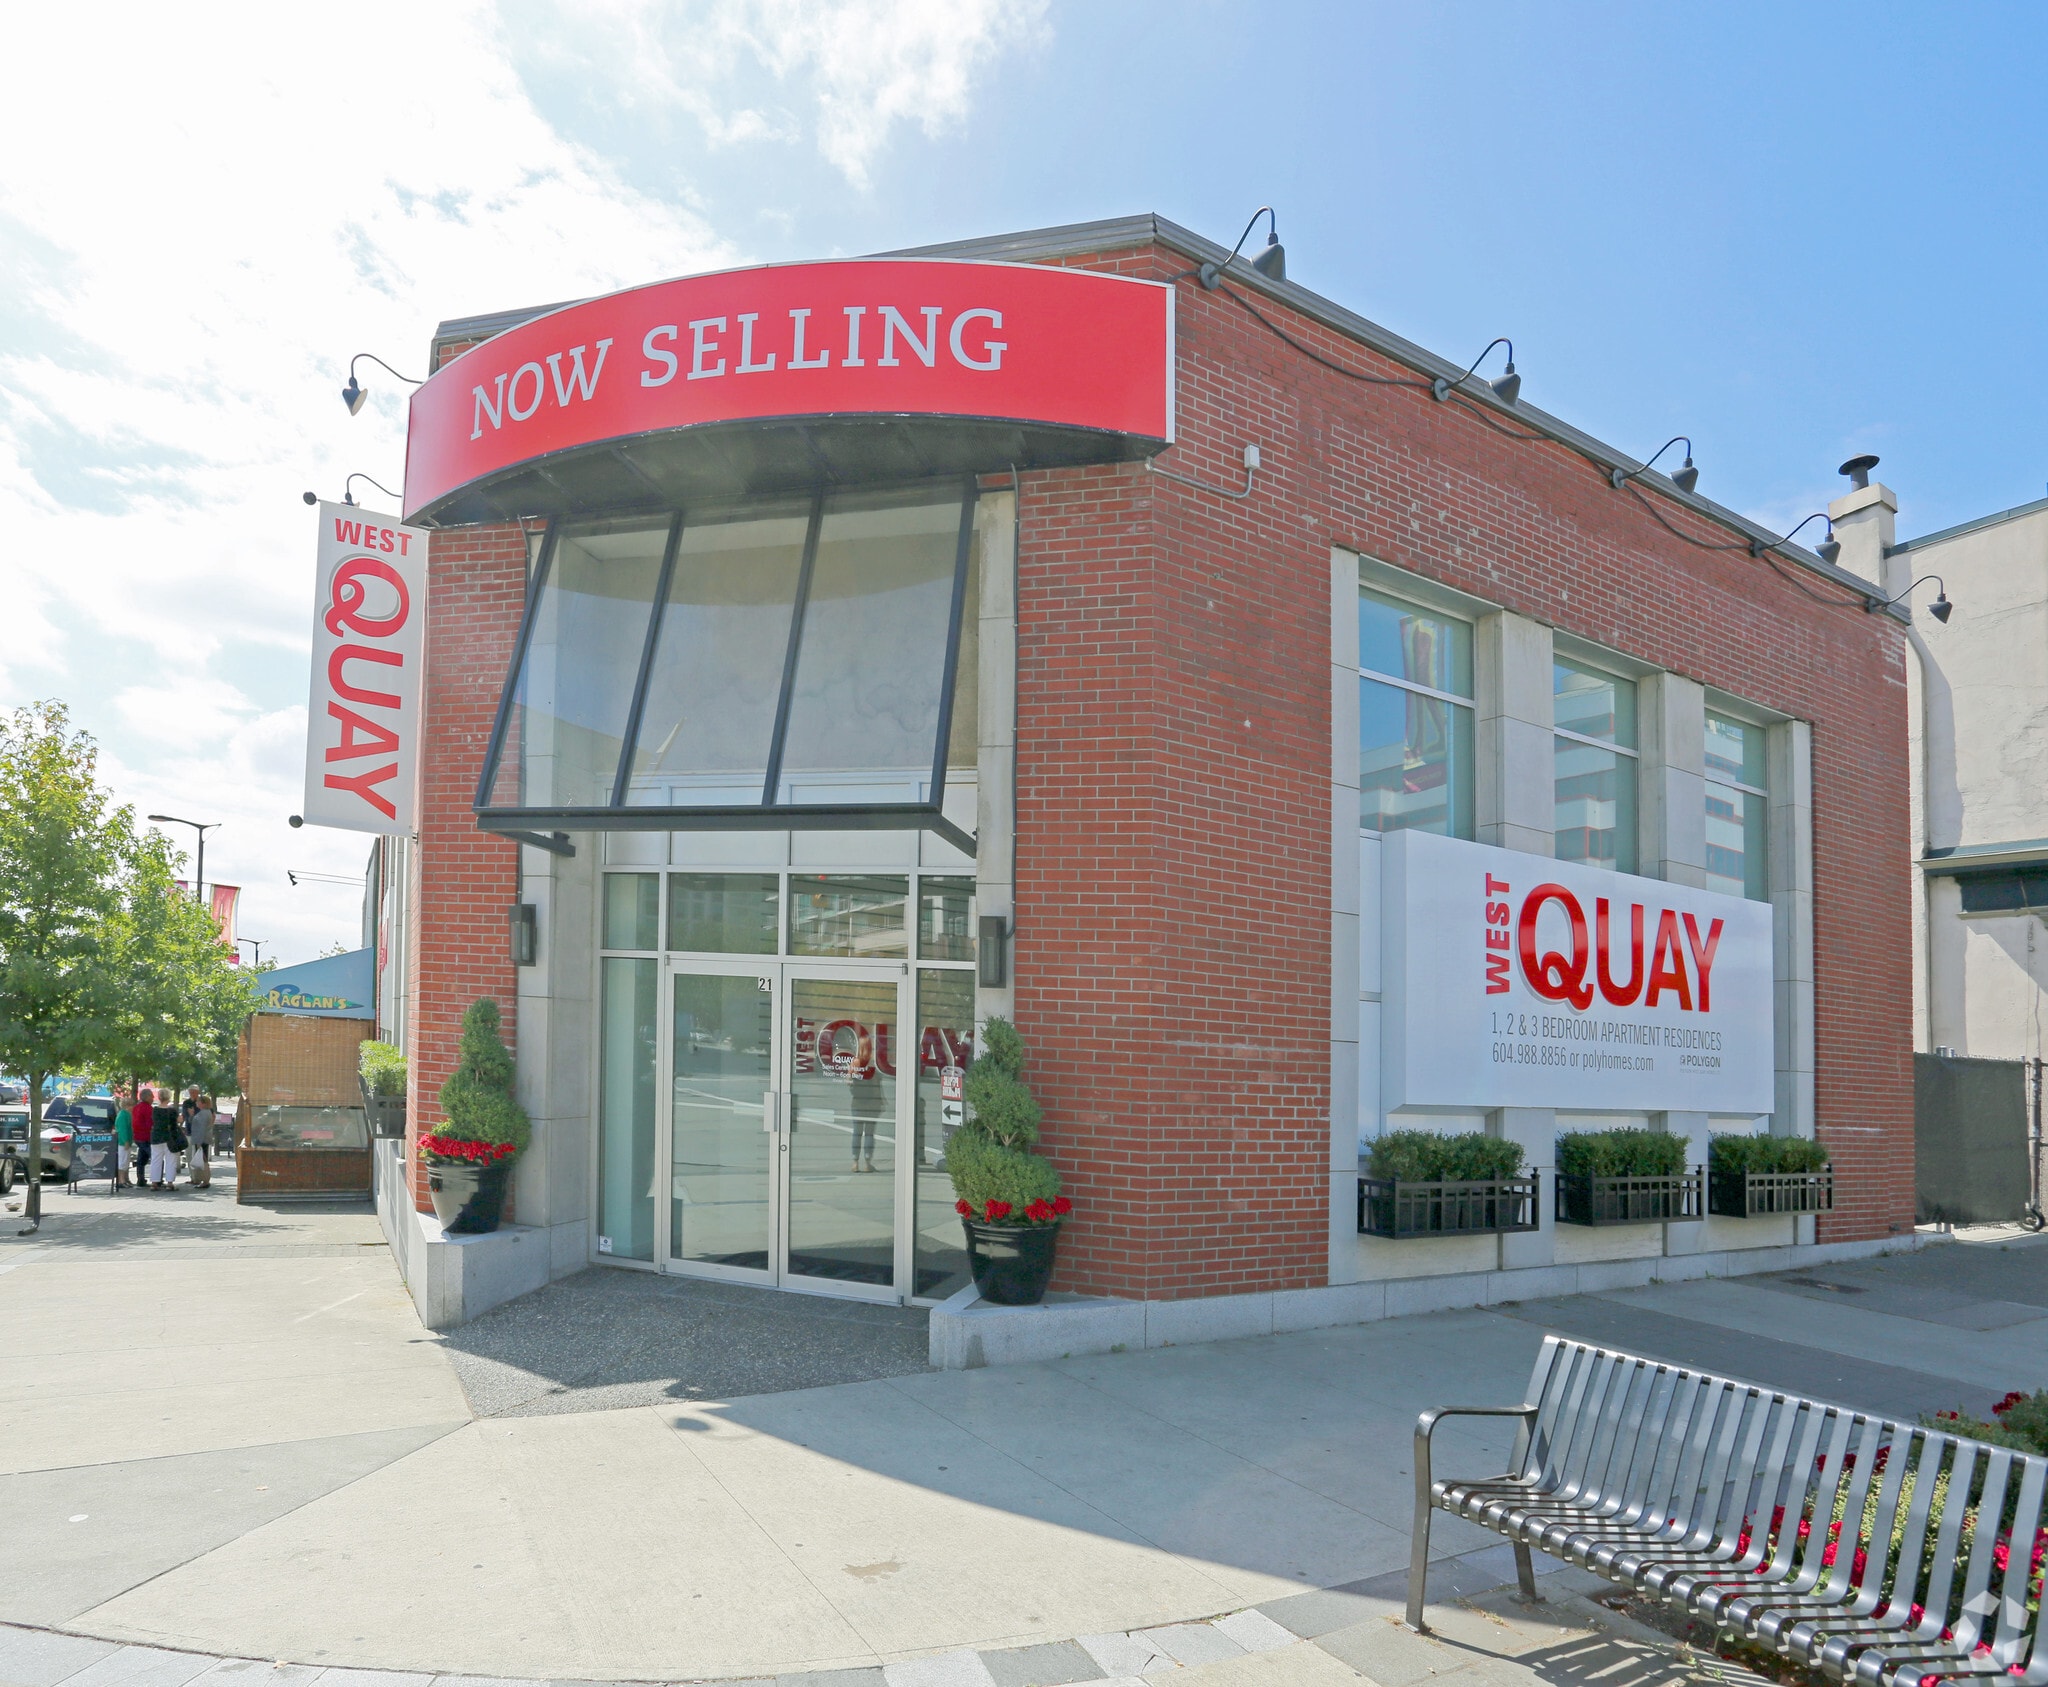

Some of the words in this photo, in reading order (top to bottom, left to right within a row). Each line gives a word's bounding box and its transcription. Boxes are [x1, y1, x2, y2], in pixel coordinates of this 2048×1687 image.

[470, 338, 613, 440] NOW
[641, 306, 1008, 388] SELLING
[335, 518, 412, 556] WEST
[324, 557, 410, 821] QUAY
[1486, 873, 1510, 994] WEST
[1518, 883, 1724, 1012] QUAY
[268, 990, 347, 1009] RAGLAN'S
[759, 977, 772, 991] 21
[796, 1017, 815, 1073] WEST
[1492, 1012, 1502, 1038] 1,
[1507, 1013, 1514, 1035] 2
[1519, 1014, 1527, 1036] &
[1531, 1015, 1538, 1037] 3
[1542, 1016, 1597, 1042] BEDROOM
[1600, 1021, 1662, 1047] APARTMENT
[1664, 1027, 1722, 1051] RESIDENCES
[1492, 1042, 1567, 1067] 604.988.8856
[1570, 1052, 1579, 1067] or
[1582, 1049, 1654, 1072] polyhomes.com
[1686, 1054, 1721, 1068] POLYGON
